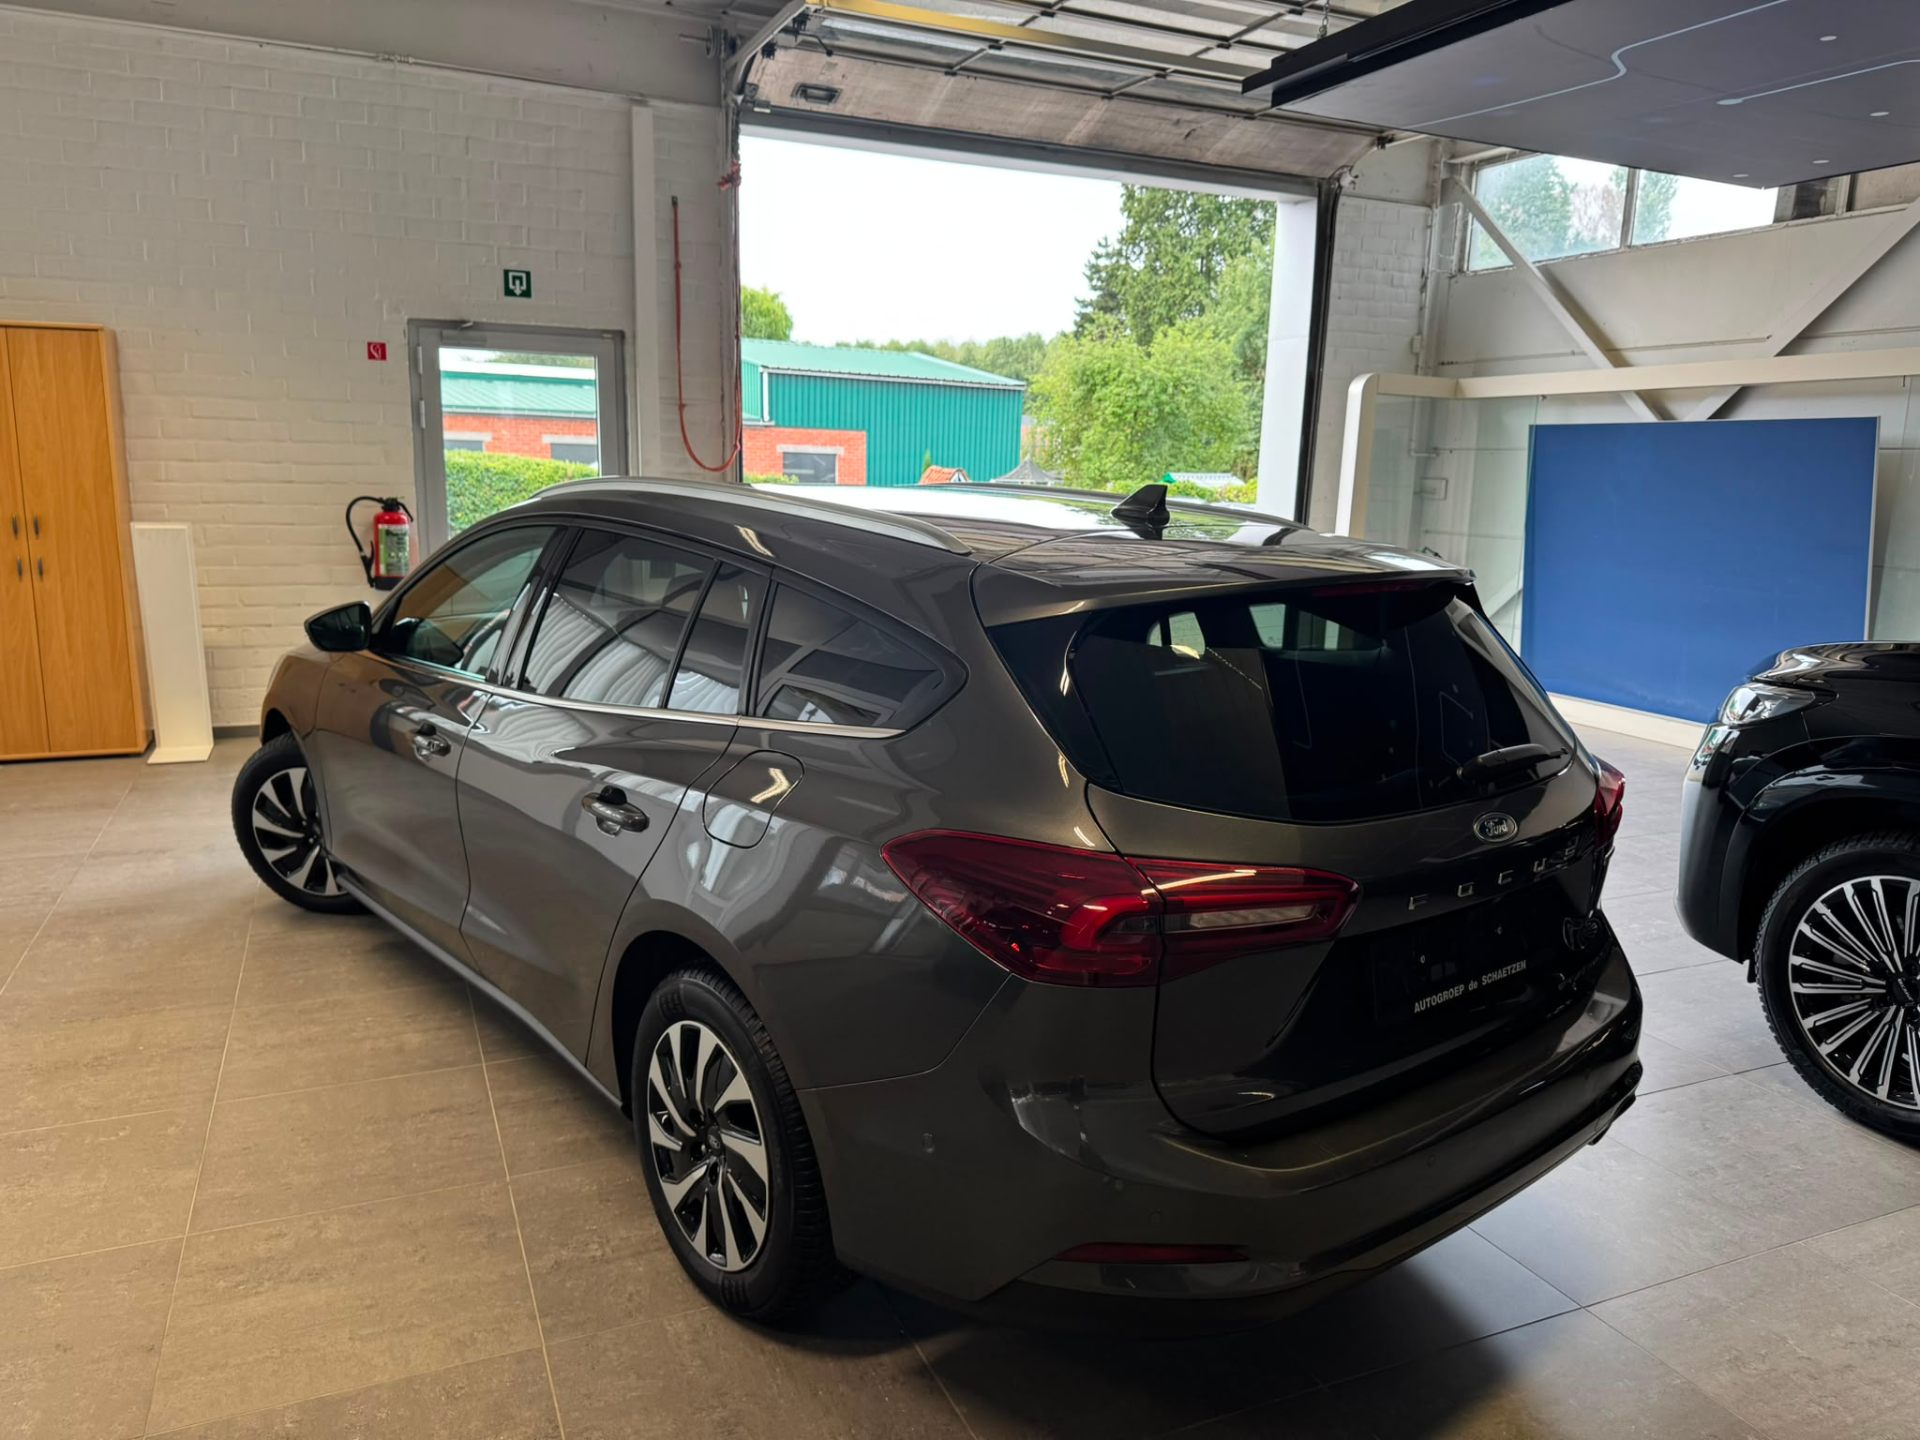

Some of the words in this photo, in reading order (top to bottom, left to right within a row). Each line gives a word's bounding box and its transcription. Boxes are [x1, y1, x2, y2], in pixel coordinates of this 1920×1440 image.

[1484, 817, 1509, 837] Ford
[1414, 984, 1465, 1013] AUTOGROEP
[1468, 980, 1478, 991] de
[1481, 960, 1527, 986] SCHAETZEN
